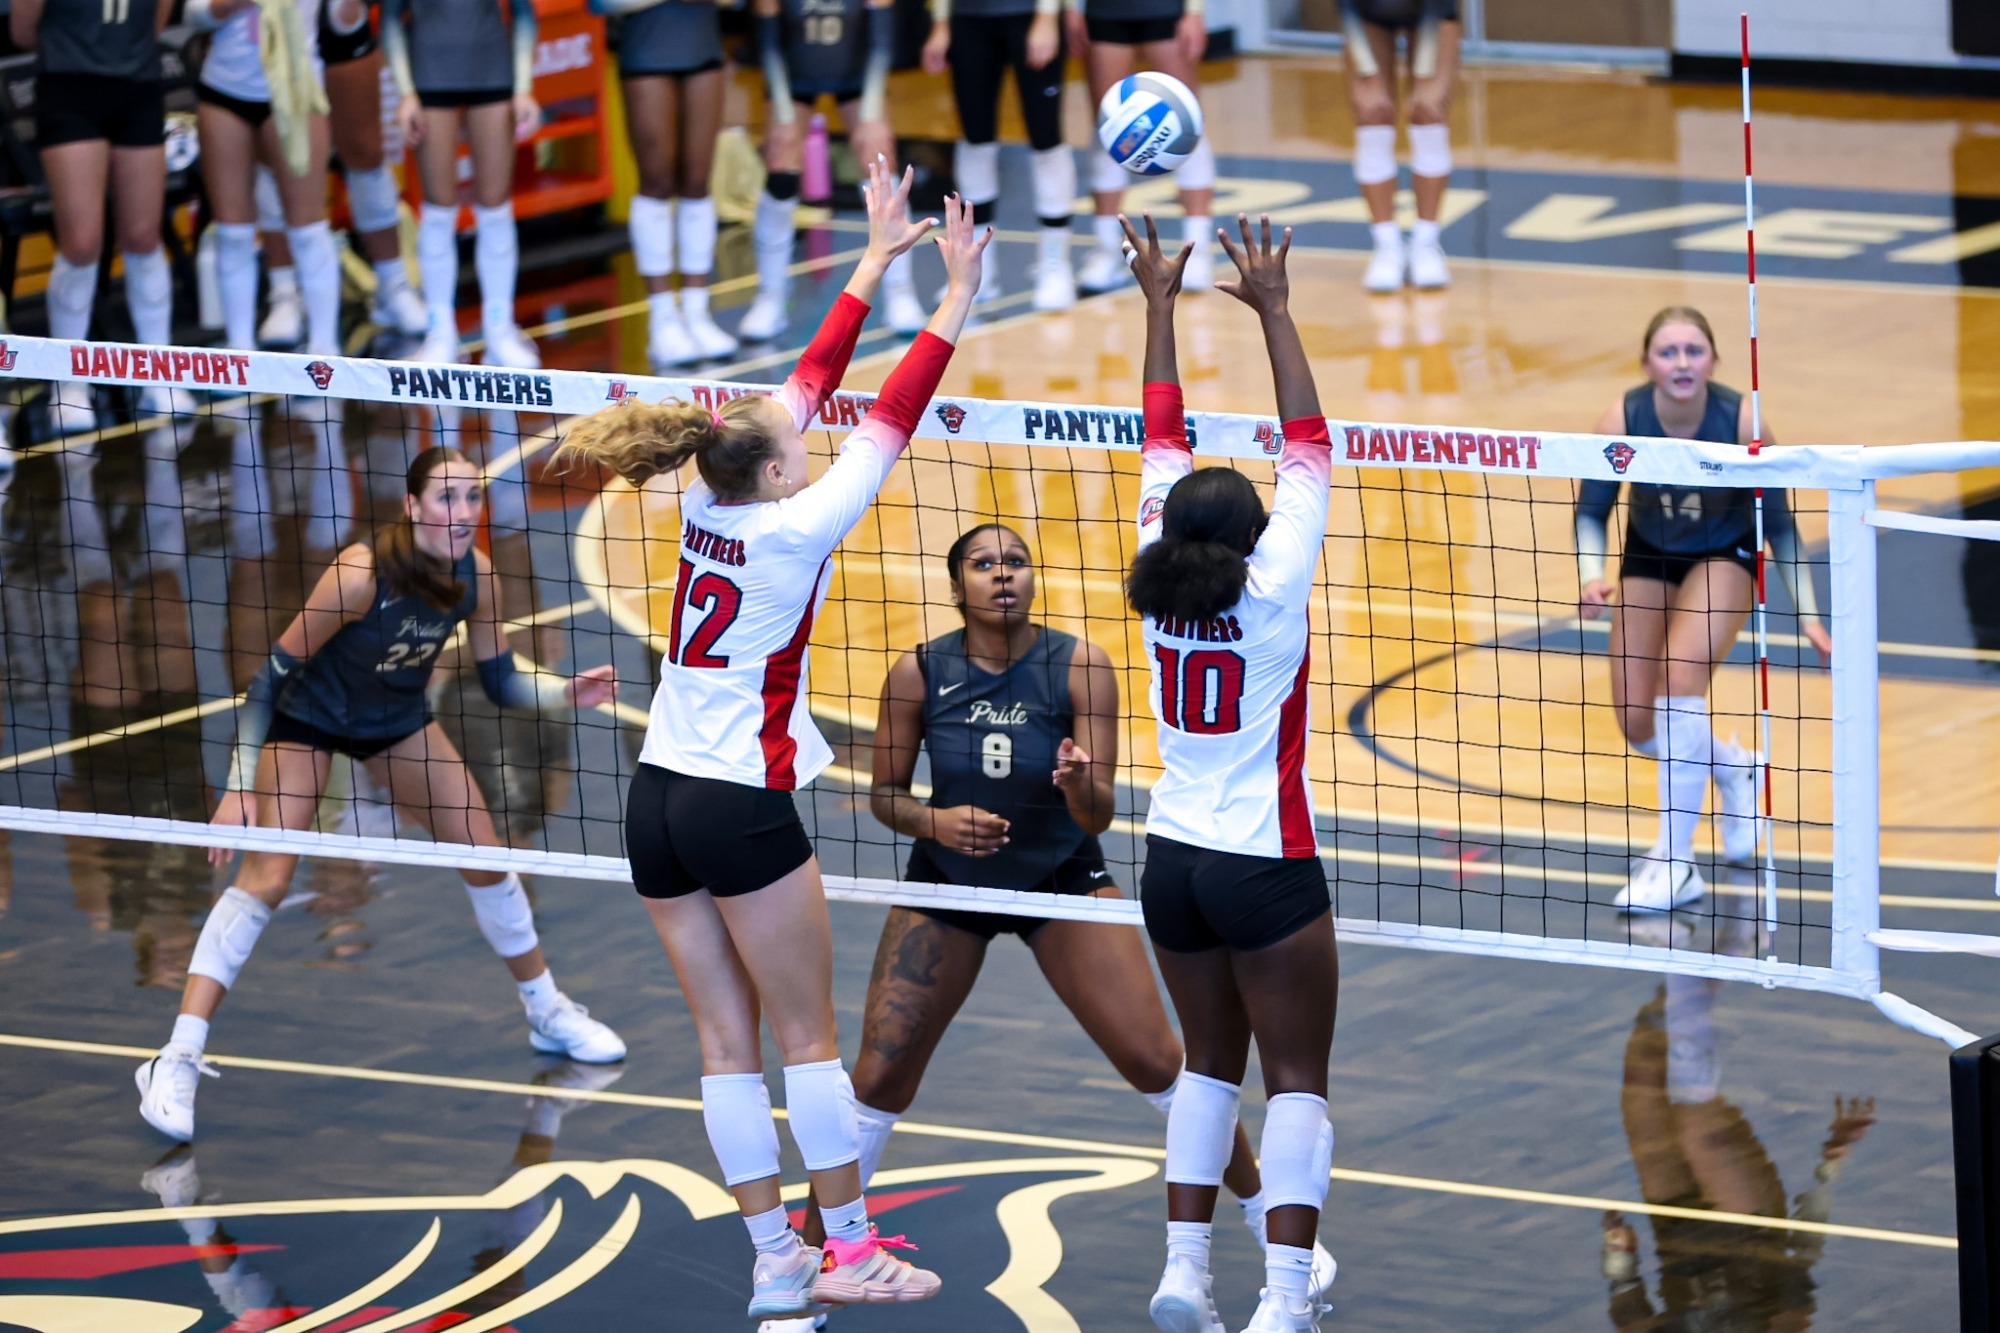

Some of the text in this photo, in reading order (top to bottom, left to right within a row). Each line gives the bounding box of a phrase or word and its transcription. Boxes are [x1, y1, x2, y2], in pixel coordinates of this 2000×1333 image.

[70, 345, 250, 386] DAVENPORT
[388, 366, 553, 407] PANTHERS
[1023, 408, 1198, 449] PANTHES
[1252, 420, 1286, 454] DU
[1344, 427, 1541, 469] DAVENPORT
[1659, 492, 1702, 521] 14
[668, 553, 743, 668] 12
[375, 642, 437, 672] 22
[1152, 641, 1247, 735] 10
[965, 700, 1028, 725] Pride
[982, 732, 1012, 779] 8
